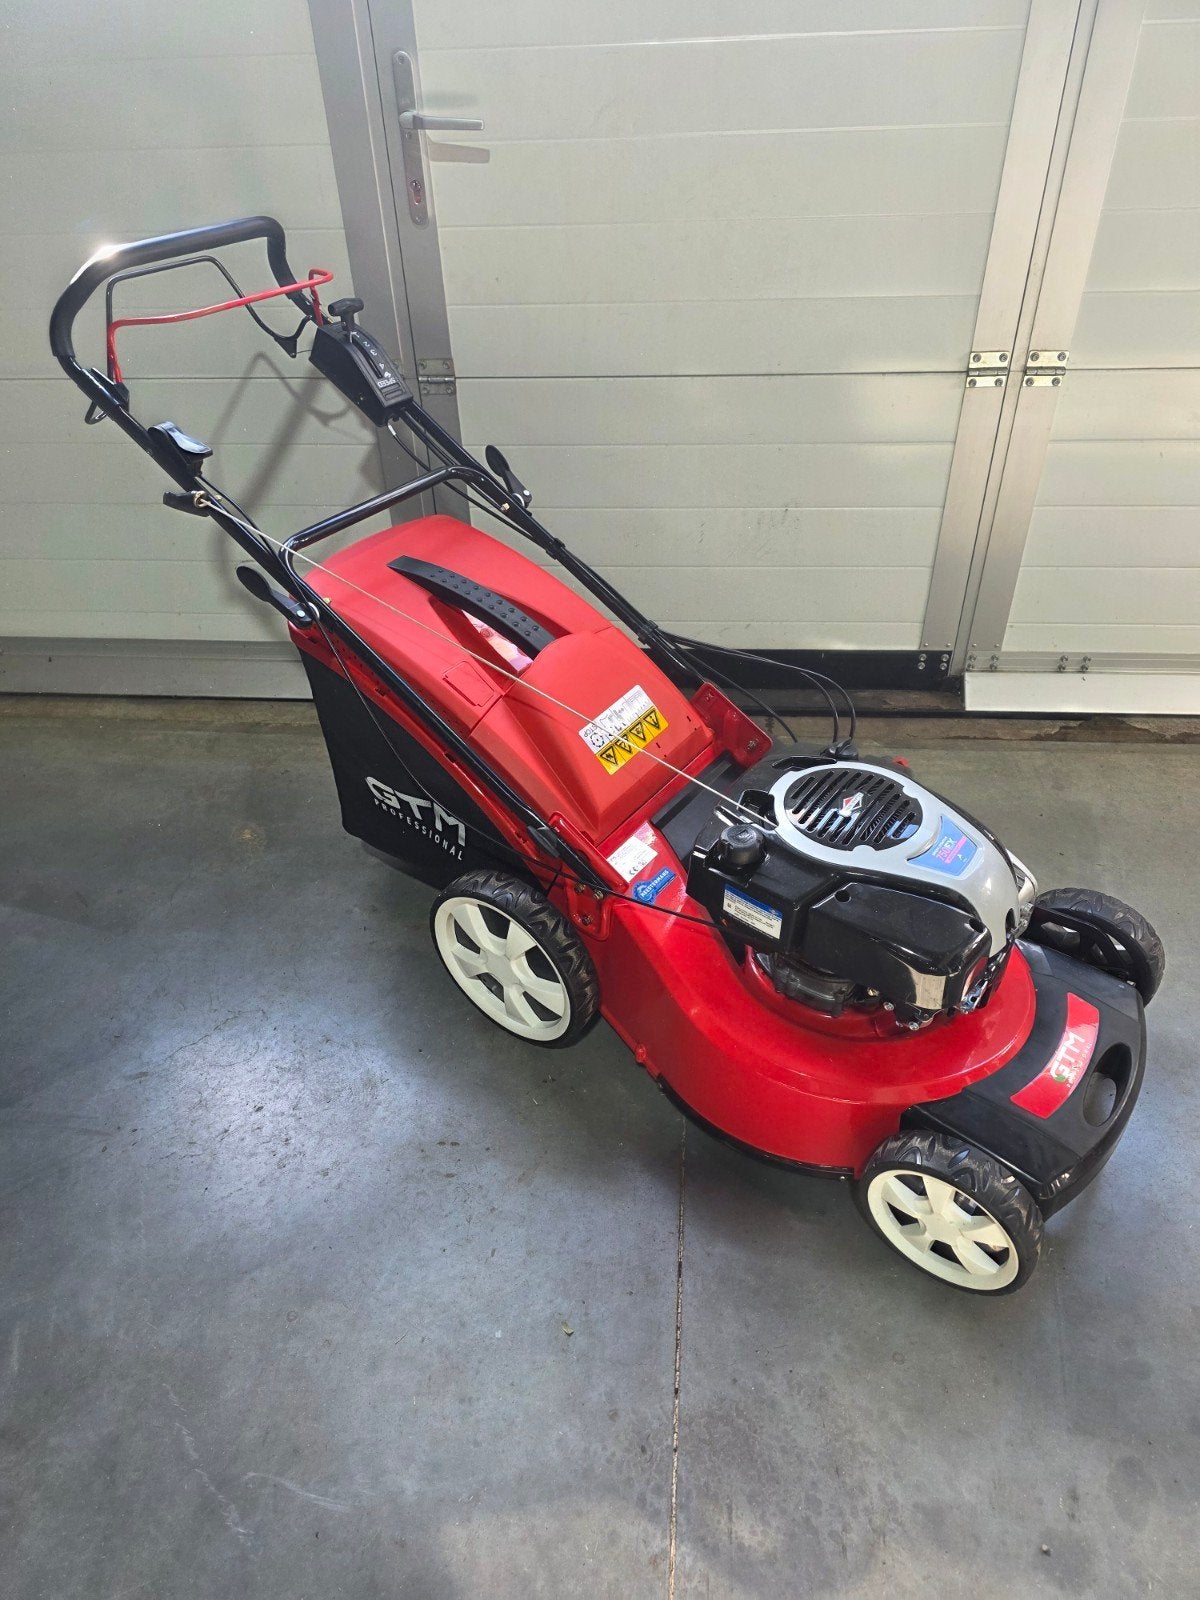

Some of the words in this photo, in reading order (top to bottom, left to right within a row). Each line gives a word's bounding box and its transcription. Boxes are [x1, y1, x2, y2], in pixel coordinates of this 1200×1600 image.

[377, 377, 395, 387] SPEED
[379, 362, 385, 370] 4
[365, 776, 466, 847] GTM
[374, 798, 463, 861] PROFESSIONAL
[1049, 1031, 1085, 1083] GTM
